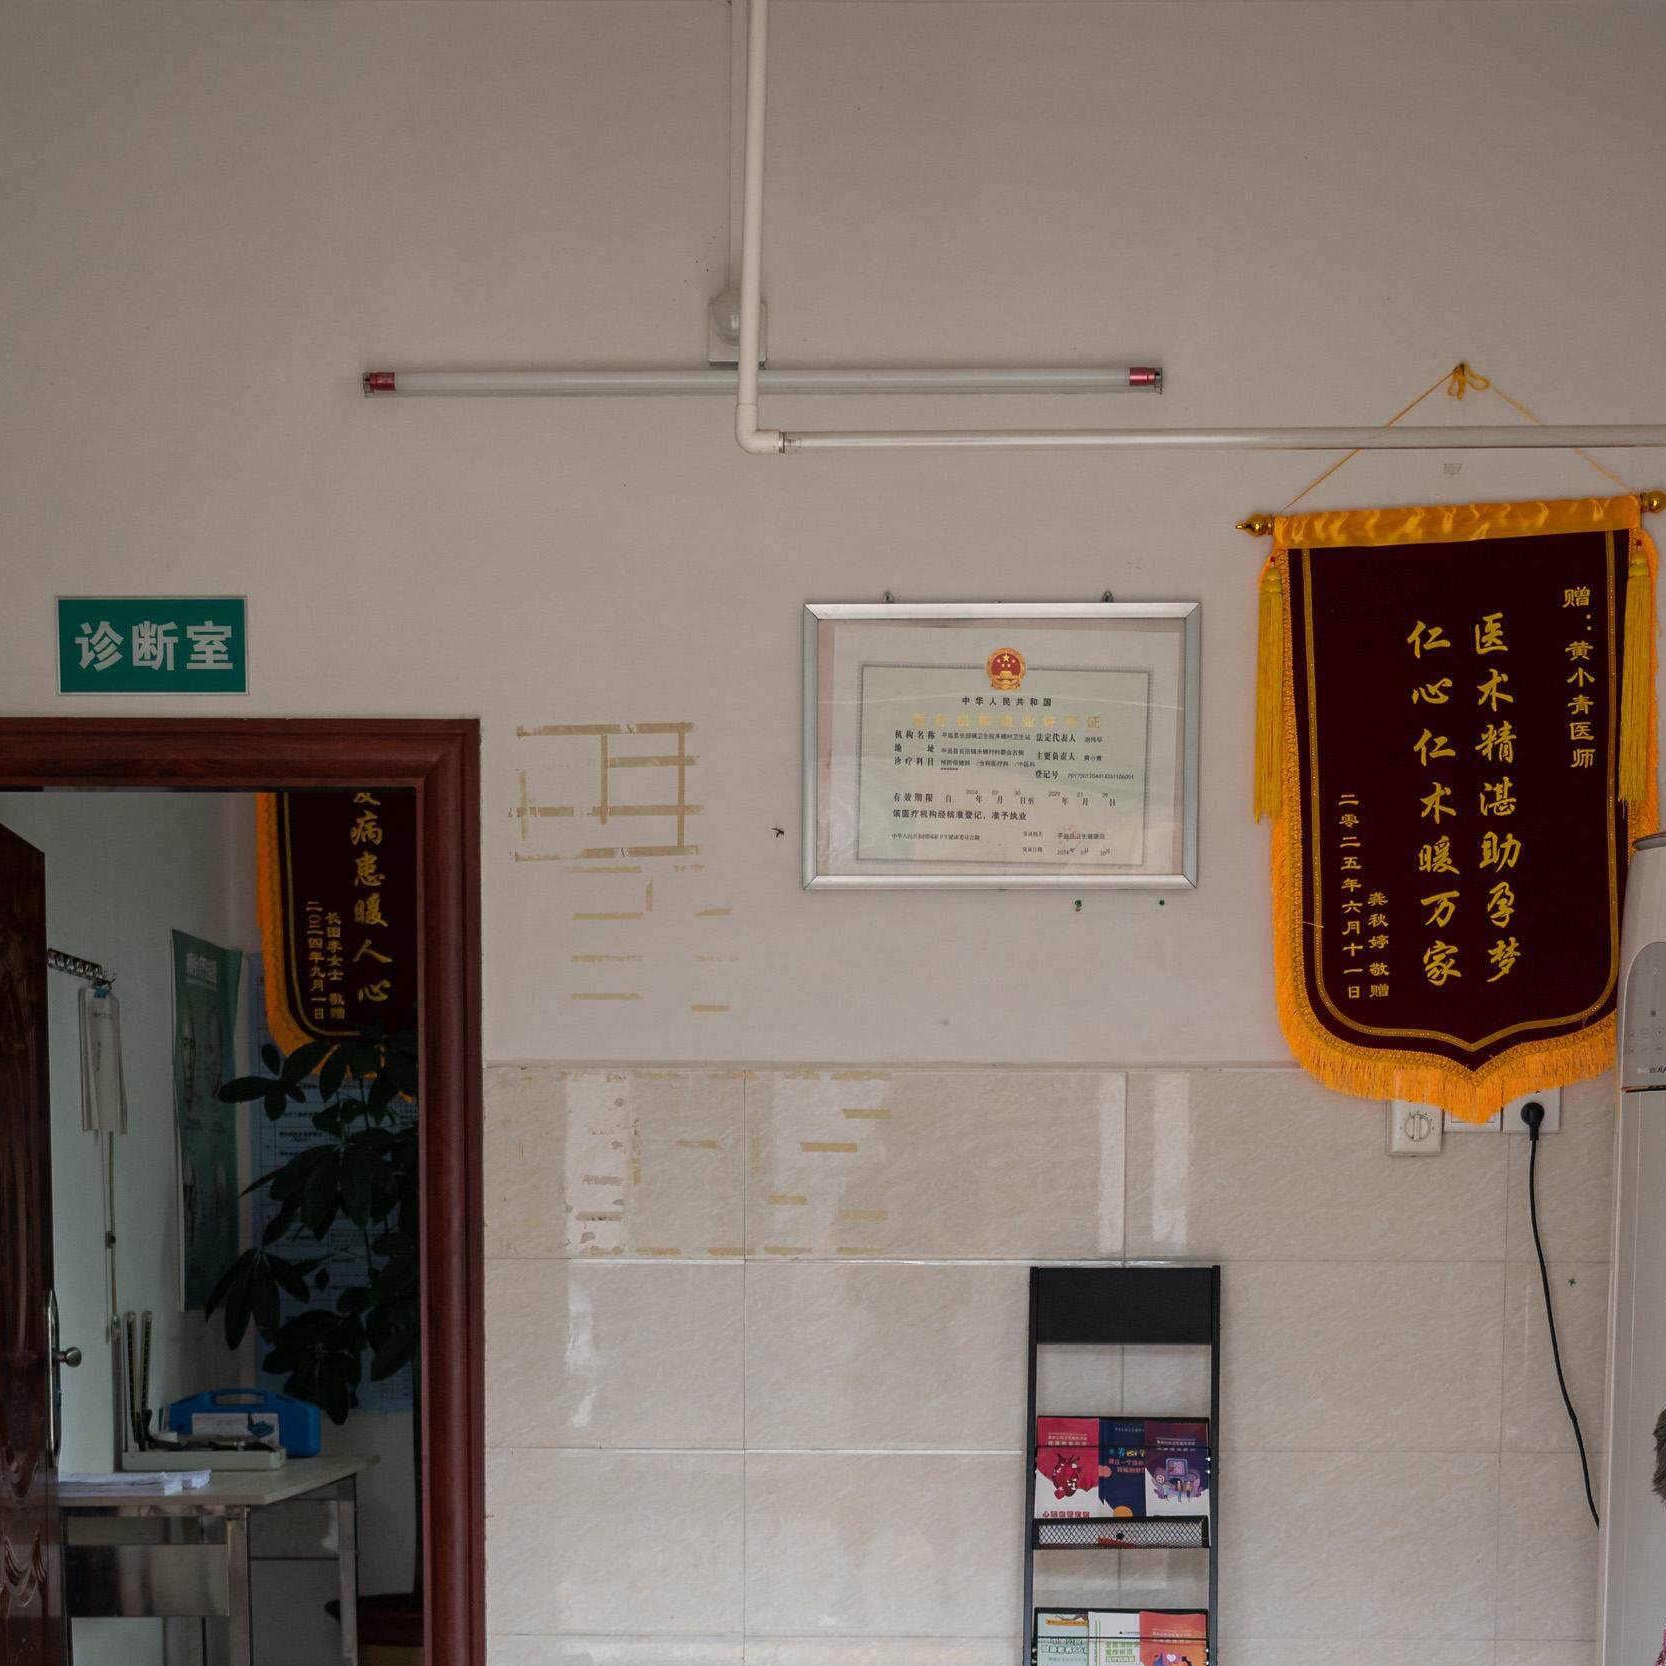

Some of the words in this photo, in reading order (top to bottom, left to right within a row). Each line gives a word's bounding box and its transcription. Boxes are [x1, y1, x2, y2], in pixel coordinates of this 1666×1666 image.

[75, 619, 234, 672] 诊断室
[1562, 586, 1596, 770] 赠：黄小青医师
[962, 696, 1052, 707] 中华人民共和国
[895, 730, 936, 740] 机构名称
[1036, 732, 1076, 743] 法定代表人
[894, 756, 935, 767] 诊疗科目
[1037, 751, 1075, 762] 主要负责人
[1035, 769, 1059, 780] 登记号
[894, 792, 933, 803] 有效期限
[945, 794, 951, 803] 自
[1406, 618, 1463, 987] 仁心仁术暖万家
[1473, 612, 1522, 984] 医术精湛助孕梦
[893, 809, 1027, 821] 该医疗机构经核准登记，准予执业
[1338, 792, 1363, 1001] 二零二五年六月十一日
[1368, 962, 1390, 998] 敬赠
